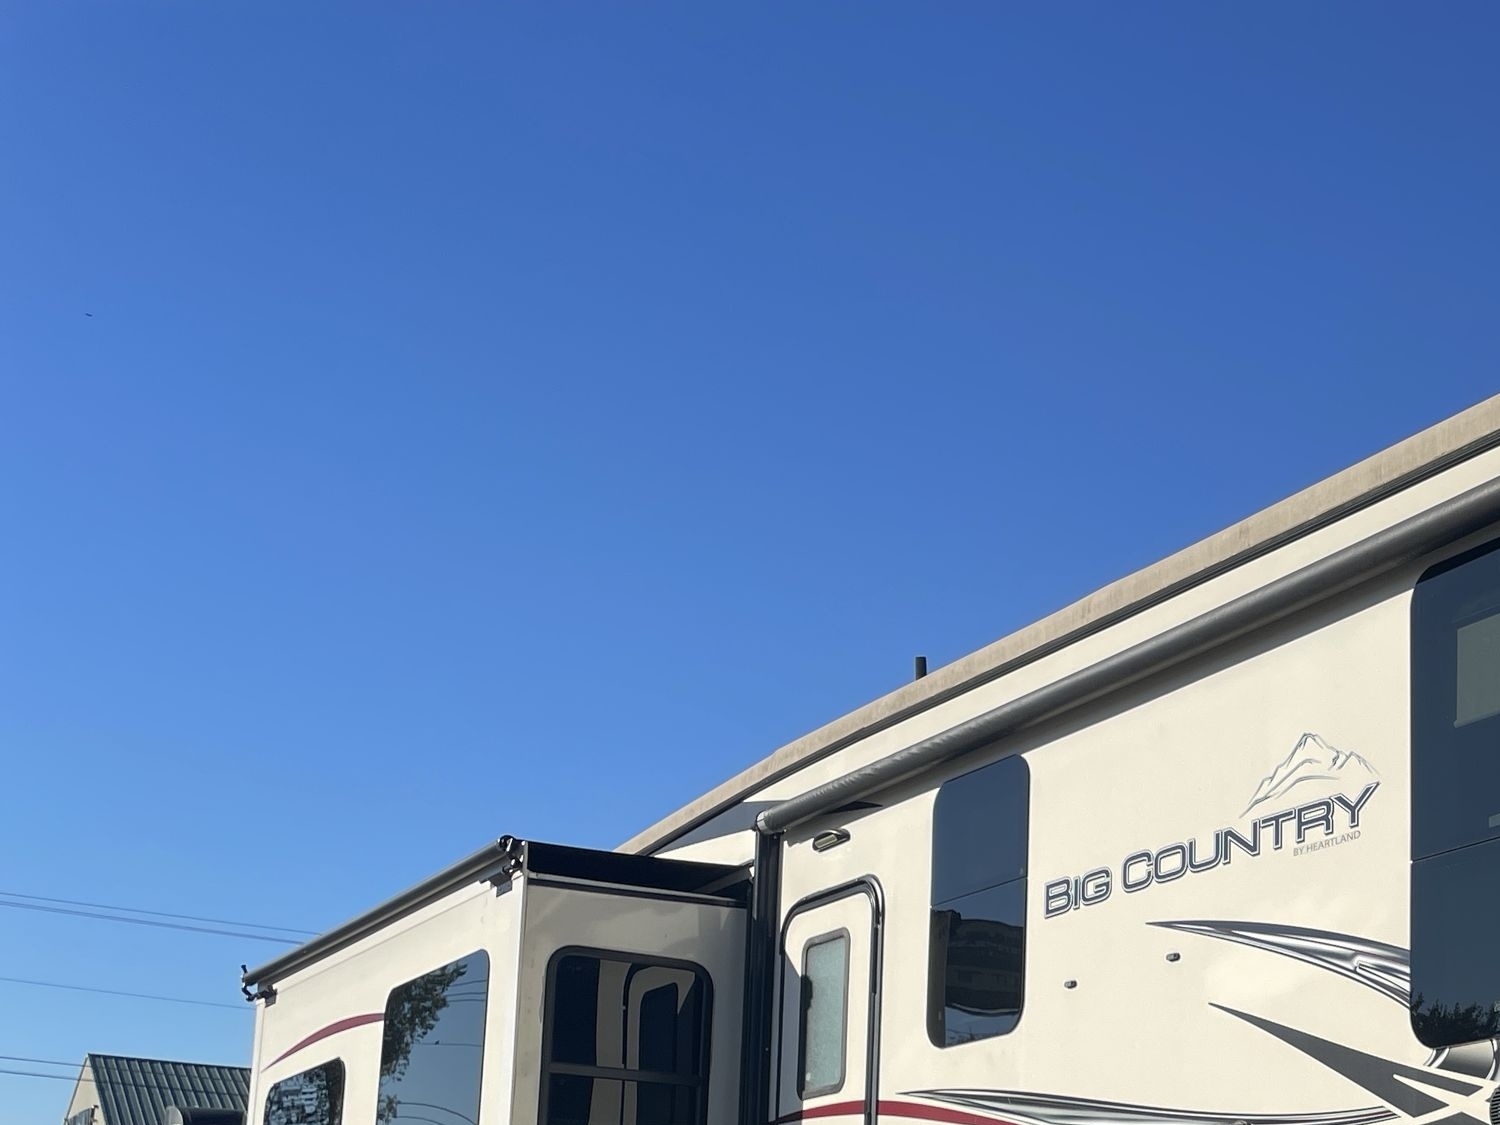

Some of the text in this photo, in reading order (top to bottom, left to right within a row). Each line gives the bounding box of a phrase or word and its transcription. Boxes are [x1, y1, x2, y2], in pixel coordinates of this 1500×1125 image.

[1044, 780, 1380, 918] BIG COUNTRY
[1293, 830, 1361, 857] BY HEARTLAND
